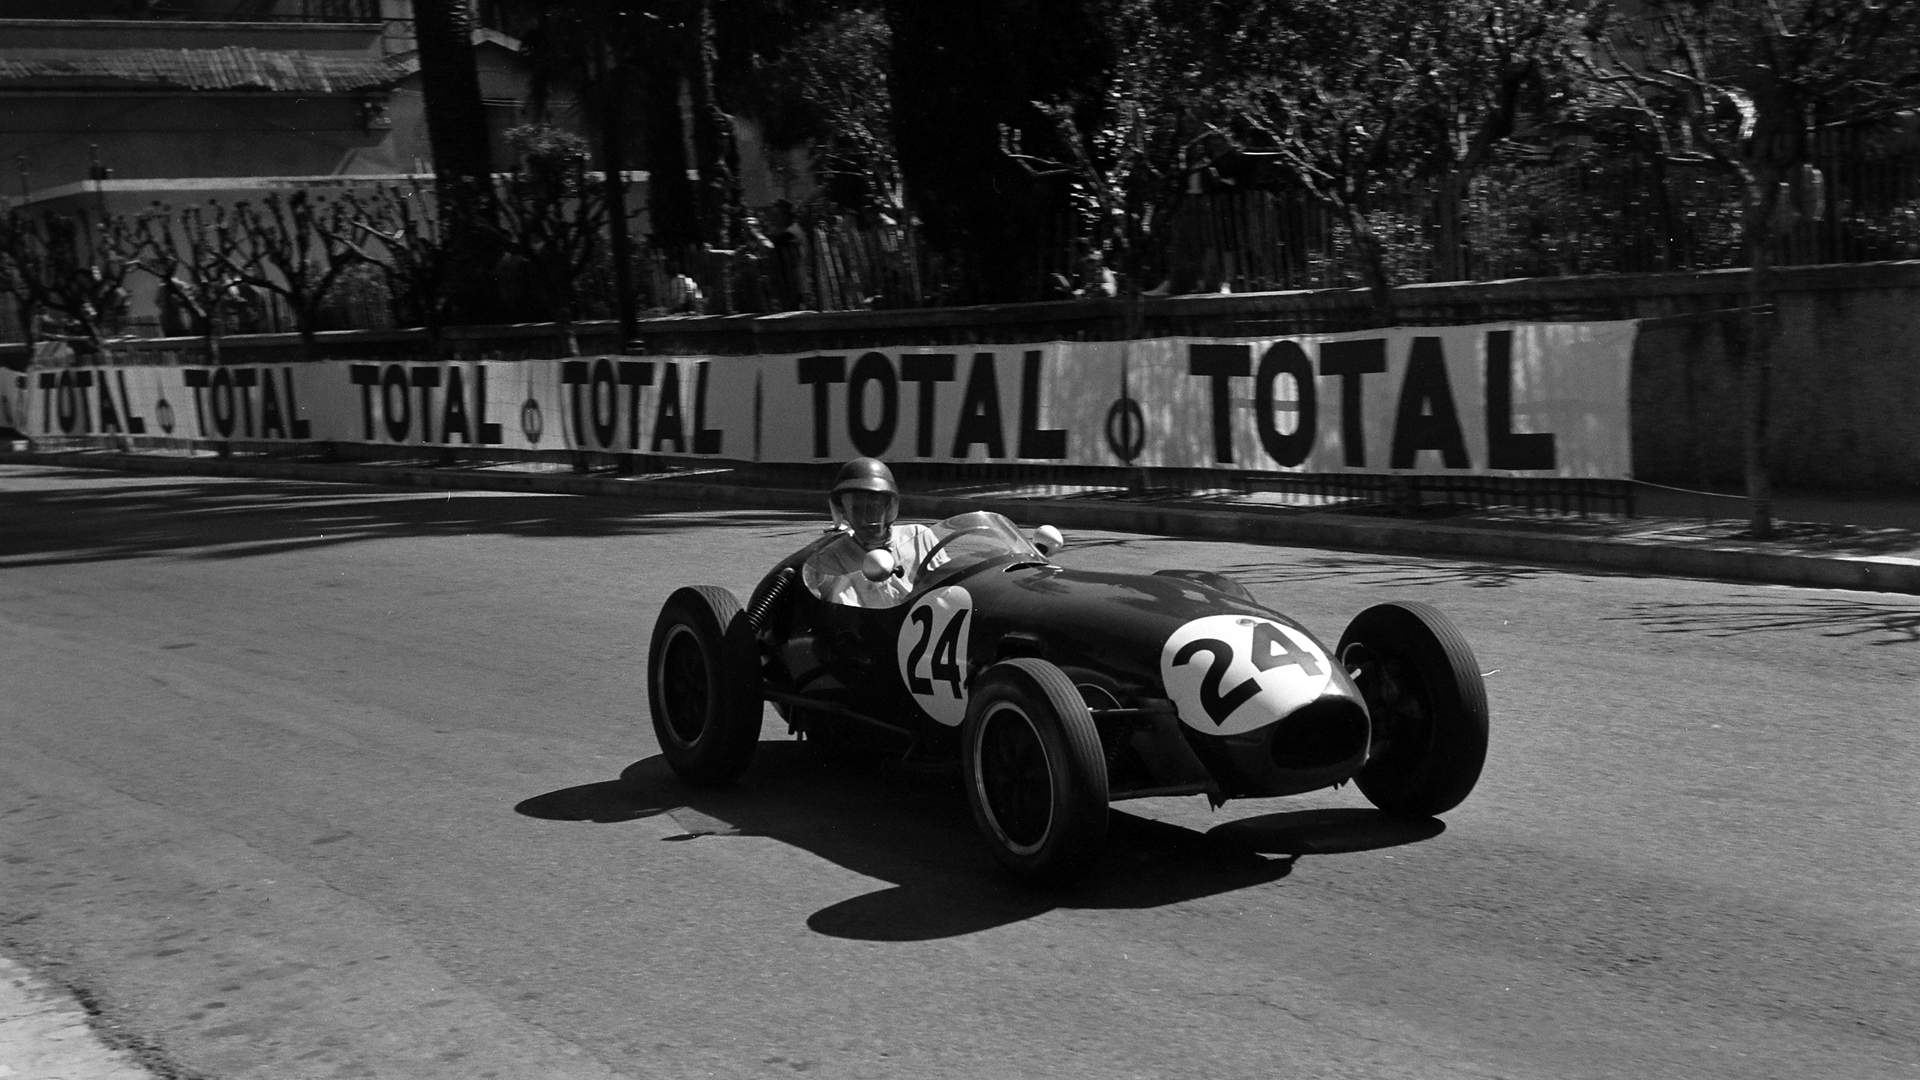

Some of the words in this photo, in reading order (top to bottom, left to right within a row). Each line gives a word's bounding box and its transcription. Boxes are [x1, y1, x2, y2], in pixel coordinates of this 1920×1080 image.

[39, 370, 147, 434] TOTAL
[184, 367, 312, 439] TOTAL
[351, 364, 503, 445] TOTAL
[562, 358, 723, 454] TOTAL
[797, 350, 1067, 459] TOTAL
[1189, 330, 1556, 470] TOTAL
[906, 604, 970, 700] 24
[1171, 622, 1326, 727] 24
